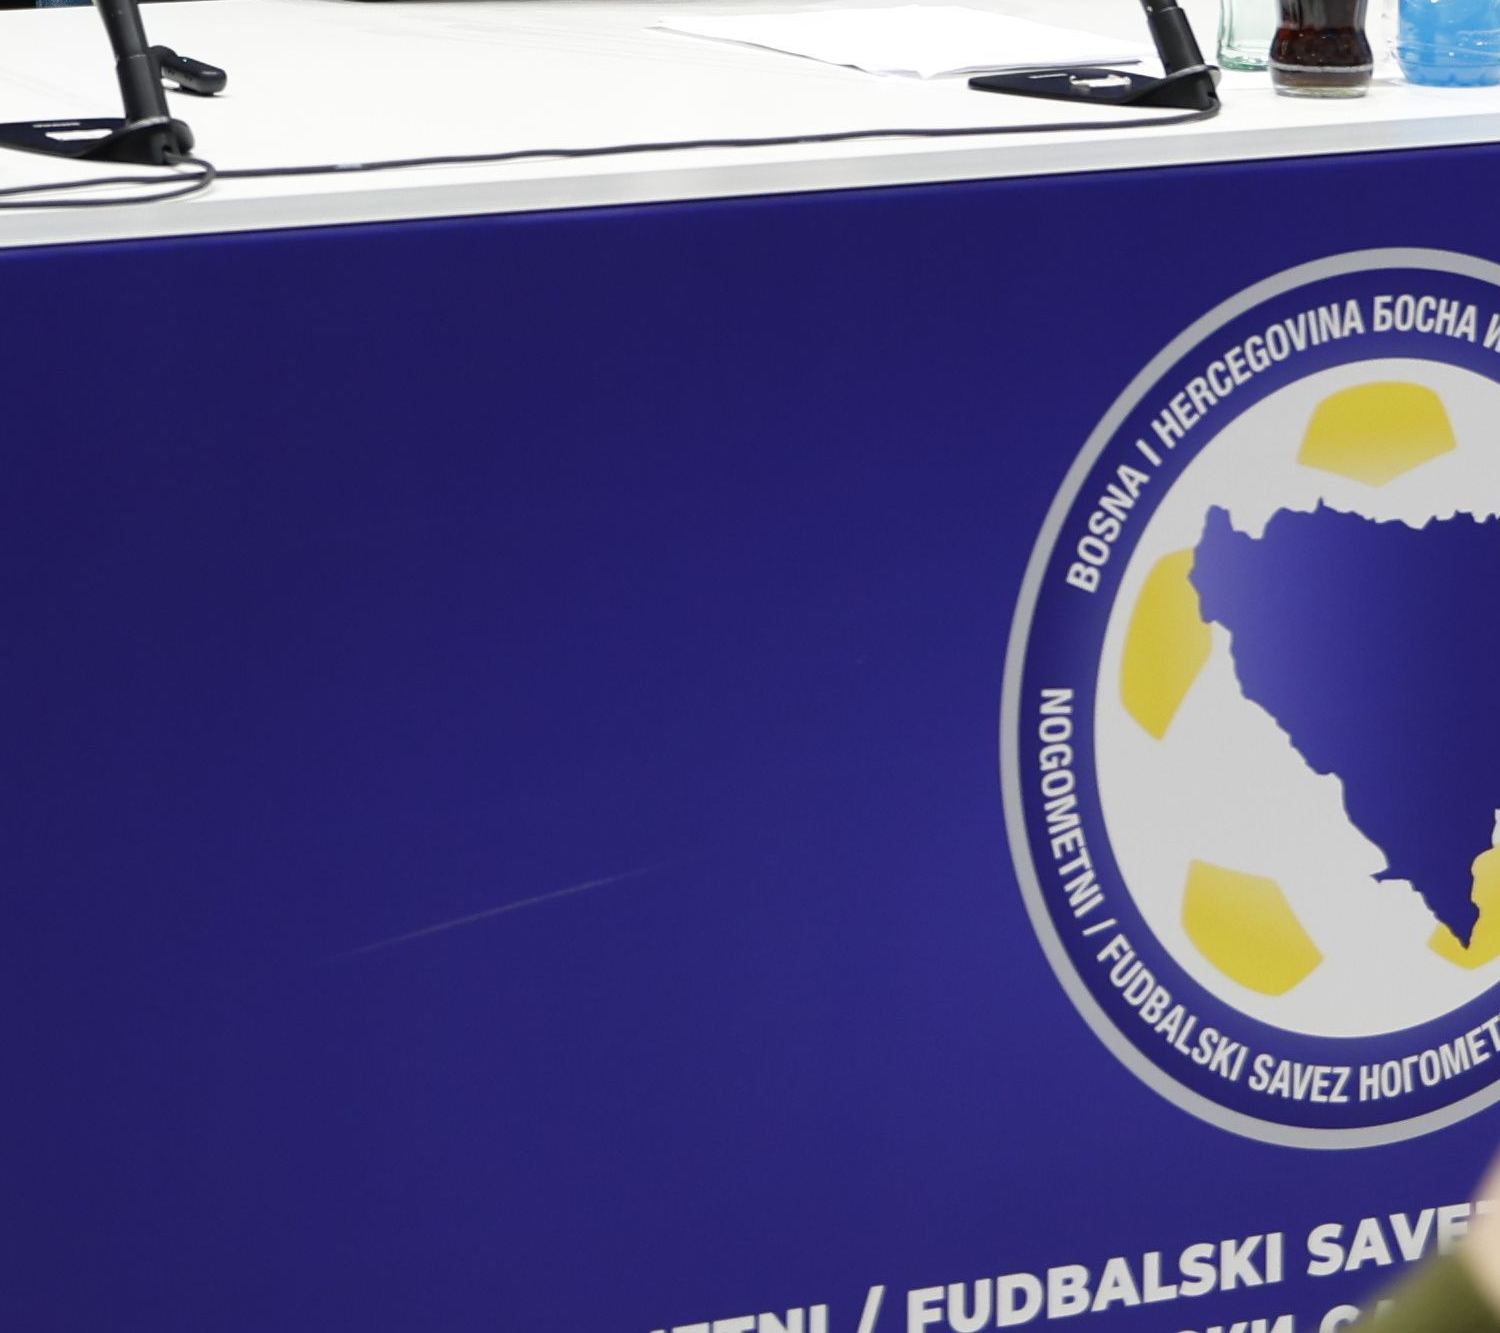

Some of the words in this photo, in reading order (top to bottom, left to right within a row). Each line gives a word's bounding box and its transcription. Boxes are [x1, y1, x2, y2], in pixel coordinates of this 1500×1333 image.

[1373, 294, 1479, 343] БОСНА
[1065, 465, 1151, 593] BOSNA
[1136, 438, 1163, 468] I
[1150, 297, 1365, 453] HERCEGOVINA
[1038, 686, 1106, 921] NOGOMETNI
[1095, 931, 1248, 1085] FUDBALSKI
[1247, 1052, 1352, 1104] SAVEZ
[905, 1232, 1284, 1333] FUDBALSKI
[1306, 1198, 1498, 1277] SAVE
